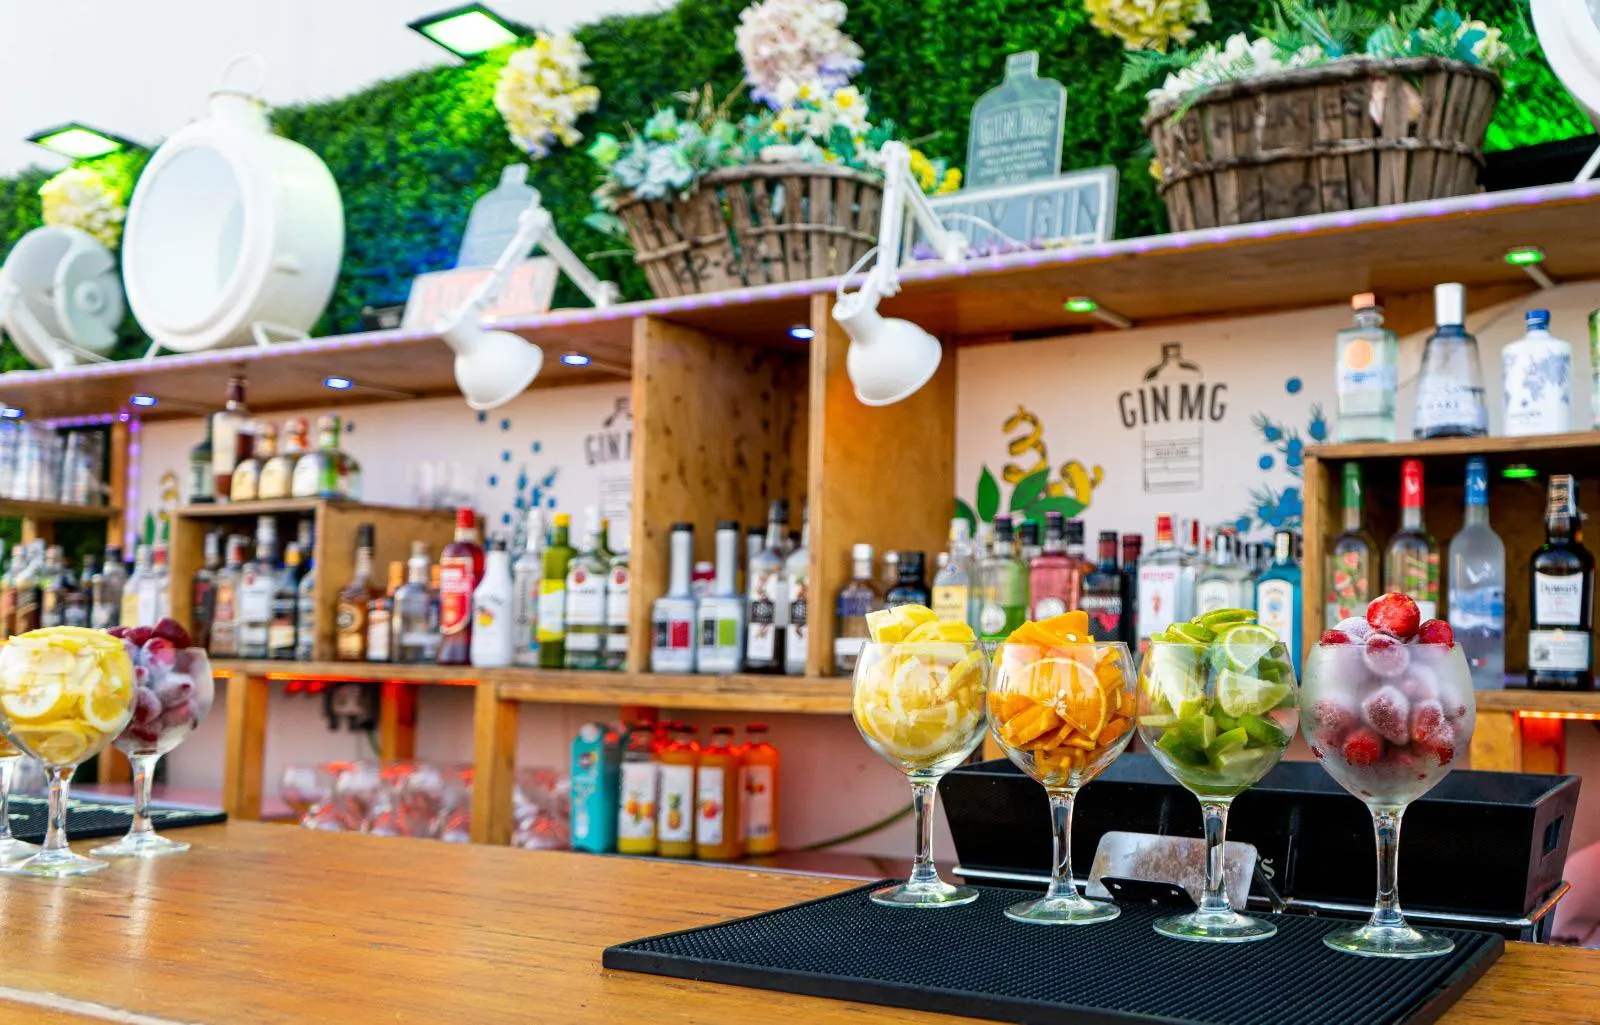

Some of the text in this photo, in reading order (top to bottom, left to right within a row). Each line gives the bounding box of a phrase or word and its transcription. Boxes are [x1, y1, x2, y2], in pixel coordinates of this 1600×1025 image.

[1118, 382, 1228, 429] GIN MG
[584, 432, 621, 468] GIN
